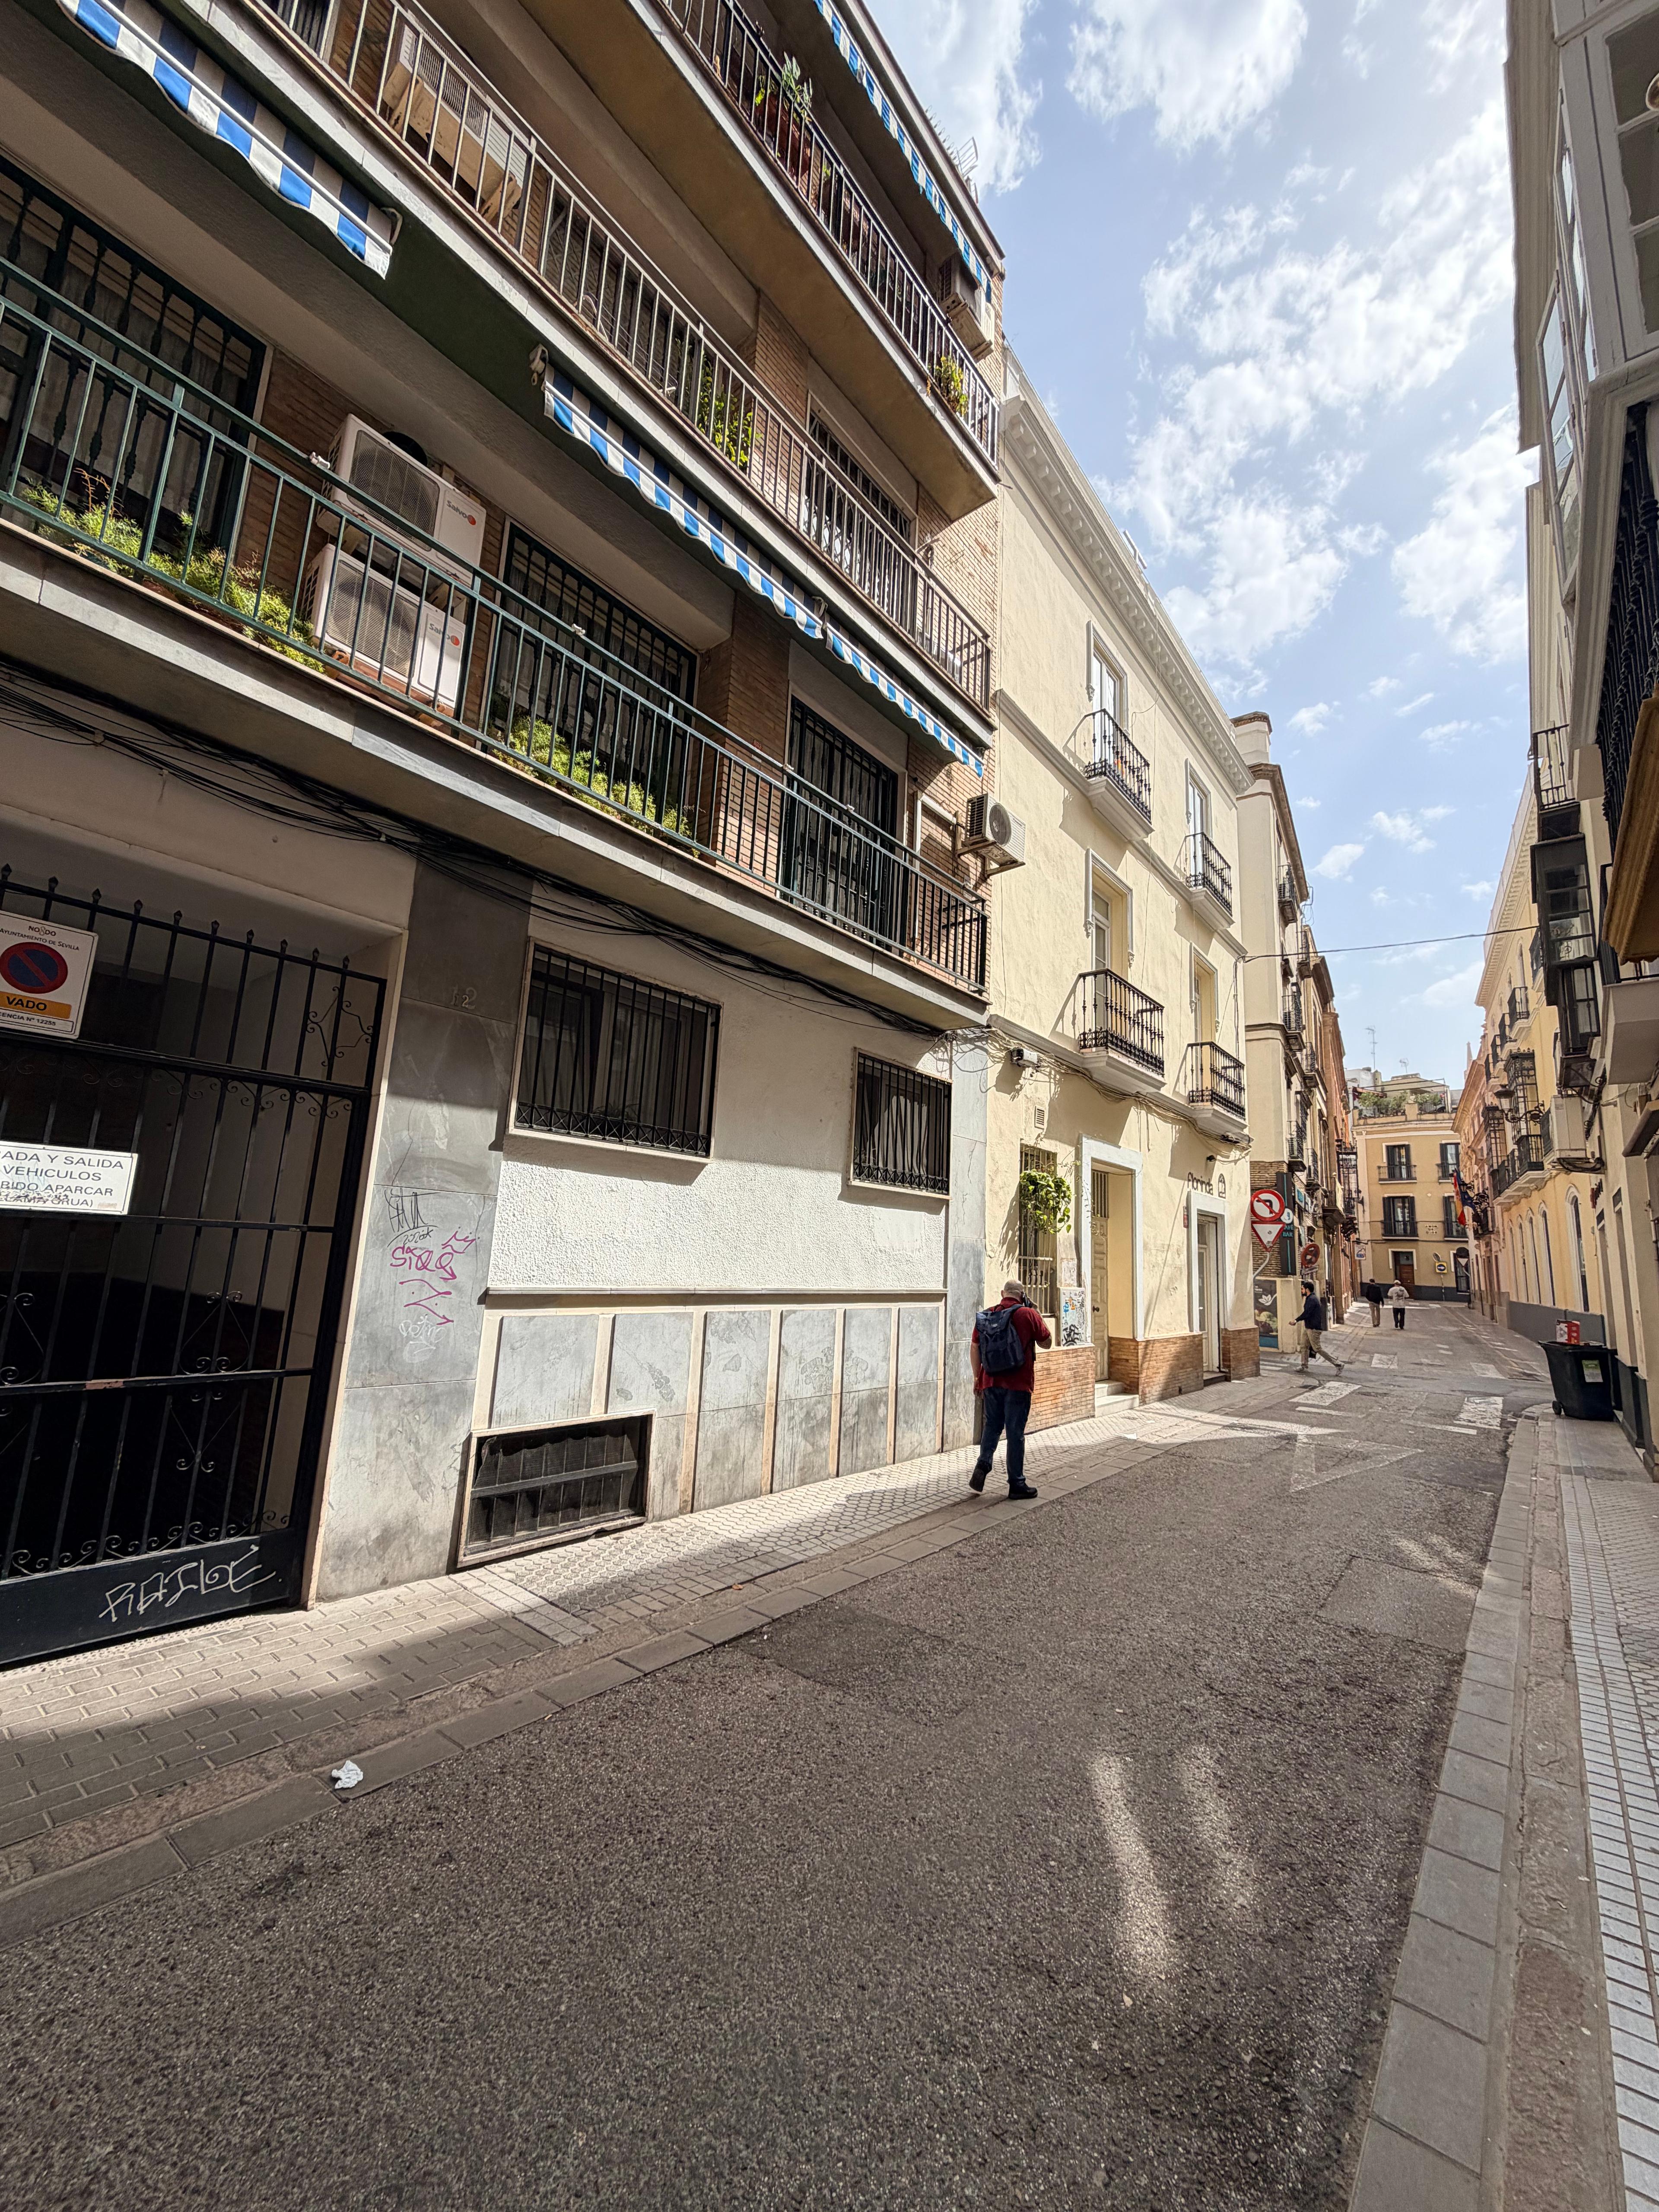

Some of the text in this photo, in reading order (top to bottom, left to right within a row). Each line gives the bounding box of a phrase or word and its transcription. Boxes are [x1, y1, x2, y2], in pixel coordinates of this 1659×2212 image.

[0, 928, 47, 943] AYUNTAMIENTO
[58, 941, 79, 951] SEVILLA
[6, 996, 47, 1011] VADO
[0, 1151, 124, 1170] ADA Y SALIDA
[3, 1165, 102, 1181] VEHICULOS
[43, 1184, 113, 1196] APARCAR
